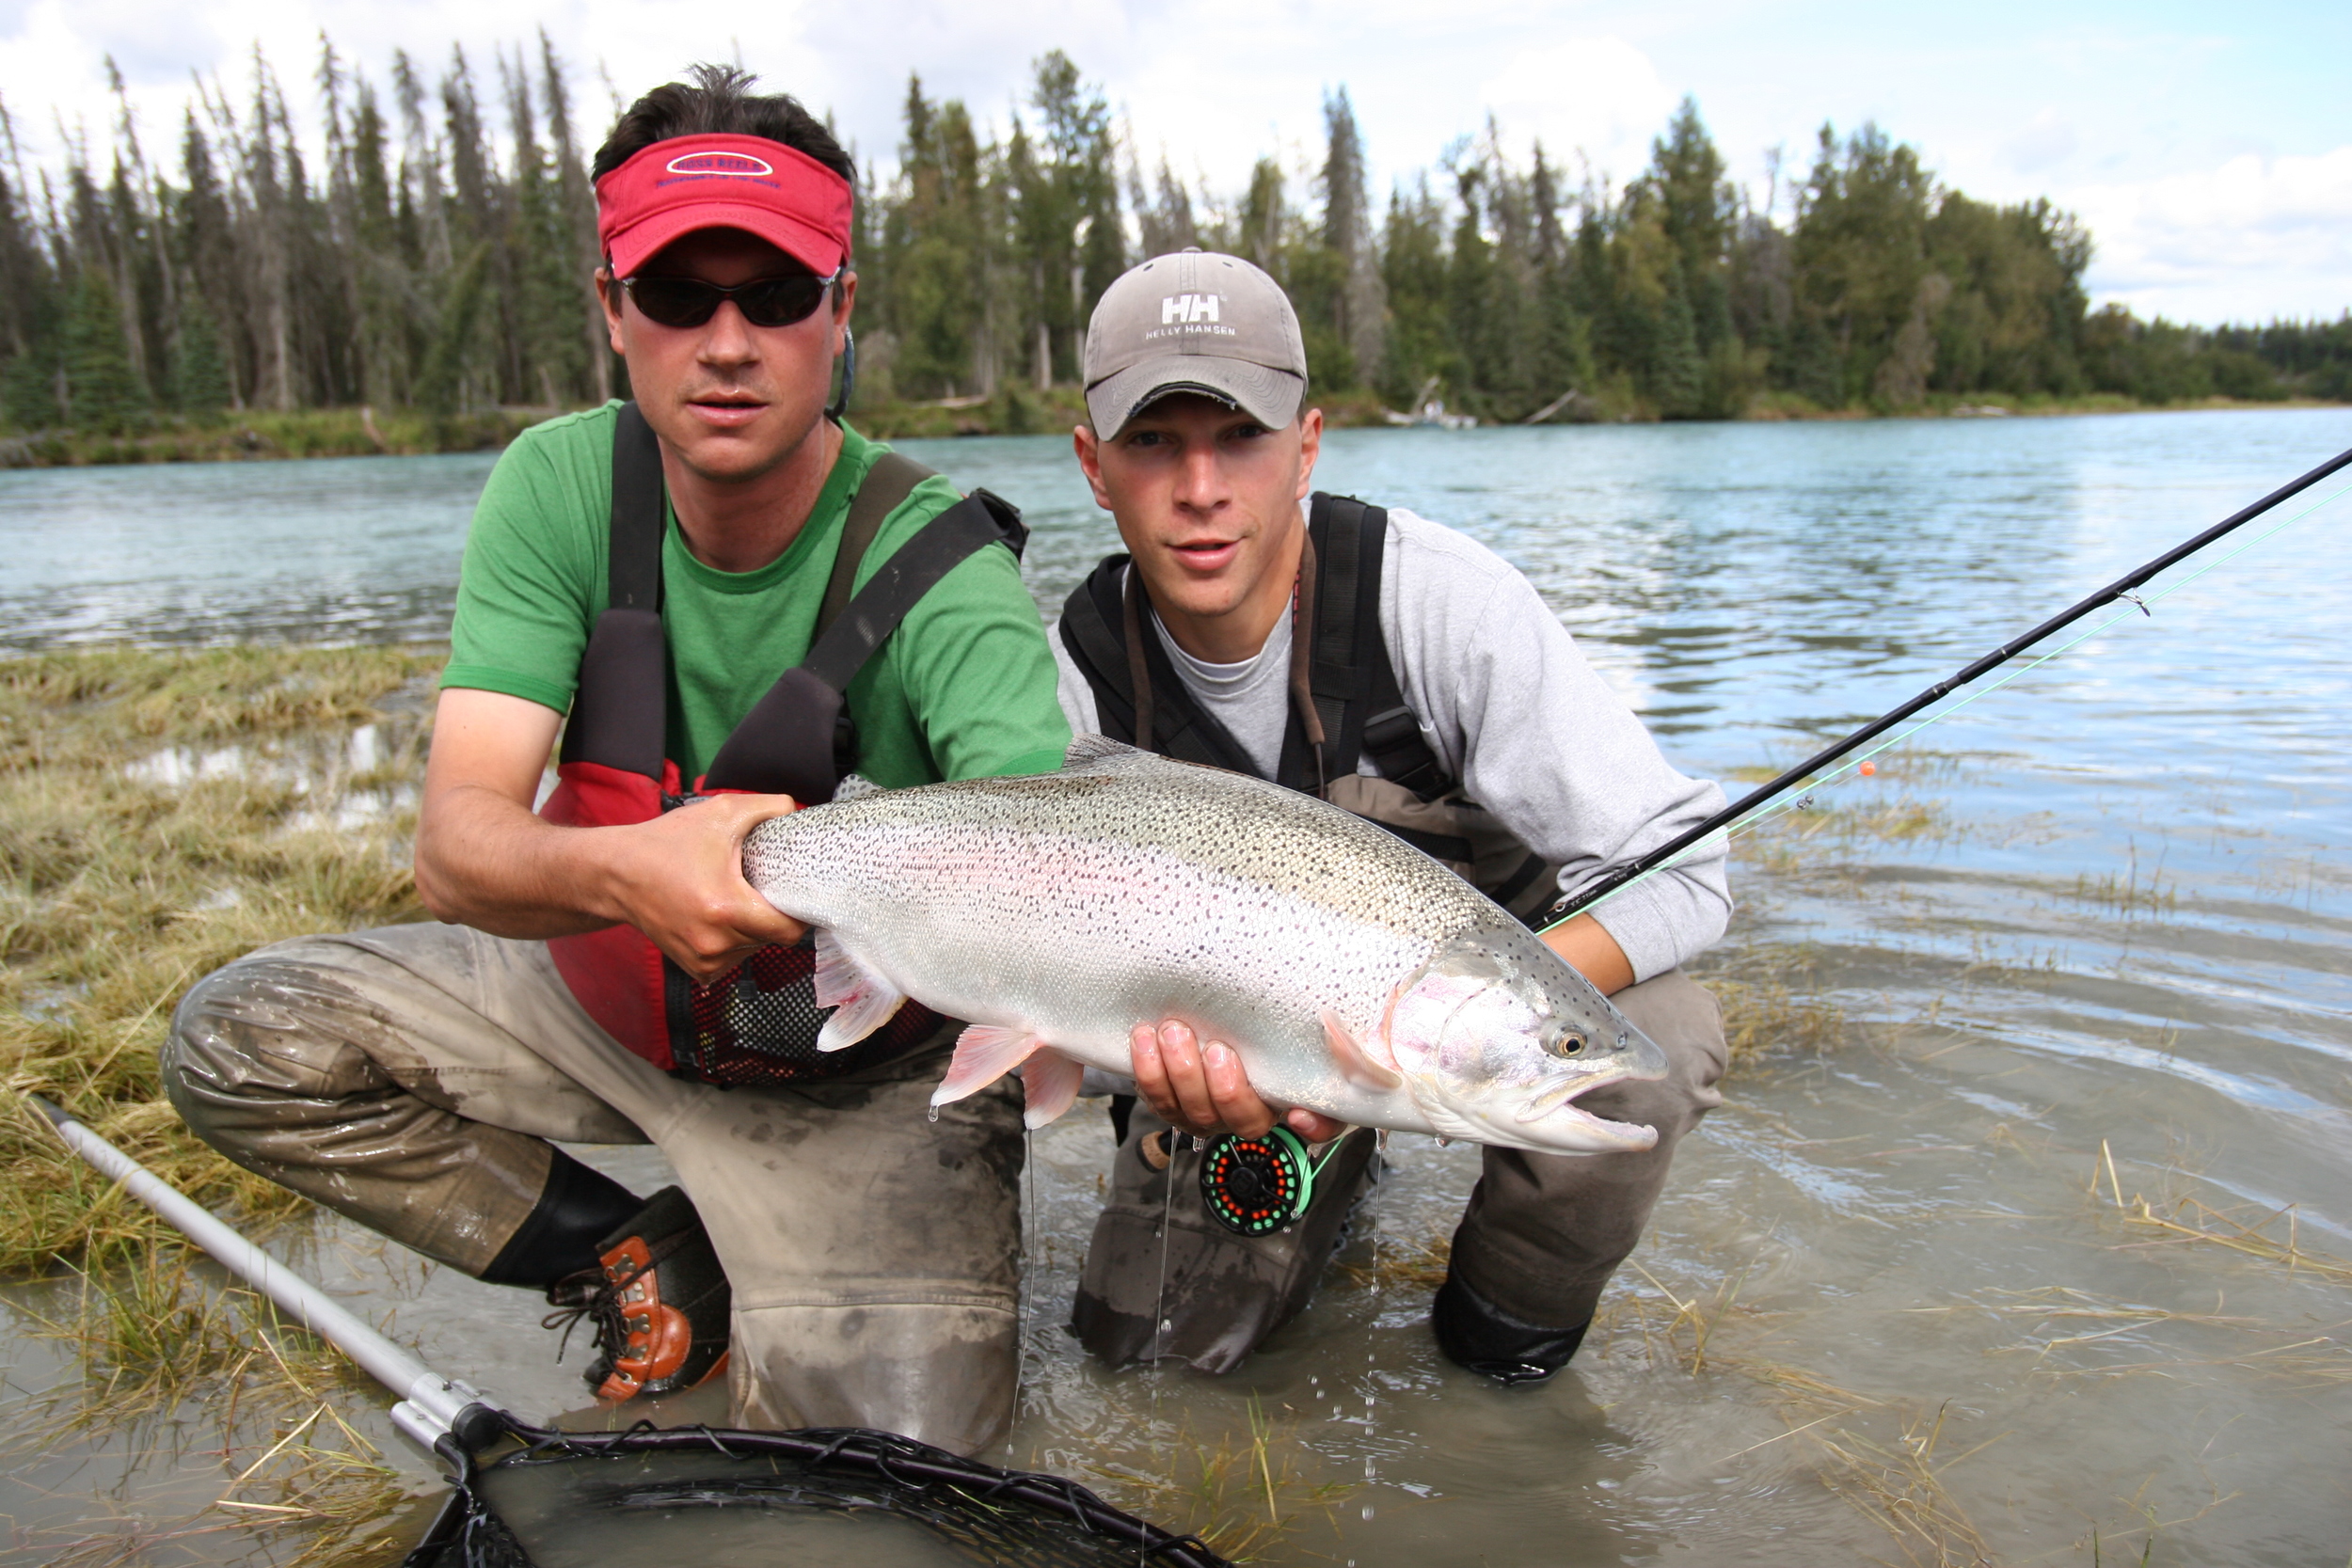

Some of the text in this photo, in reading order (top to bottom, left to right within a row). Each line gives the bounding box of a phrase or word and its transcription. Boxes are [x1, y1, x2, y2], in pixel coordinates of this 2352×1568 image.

[677, 159, 713, 169] ROSS
[1146, 325, 1235, 340] HELLY HANSEN
